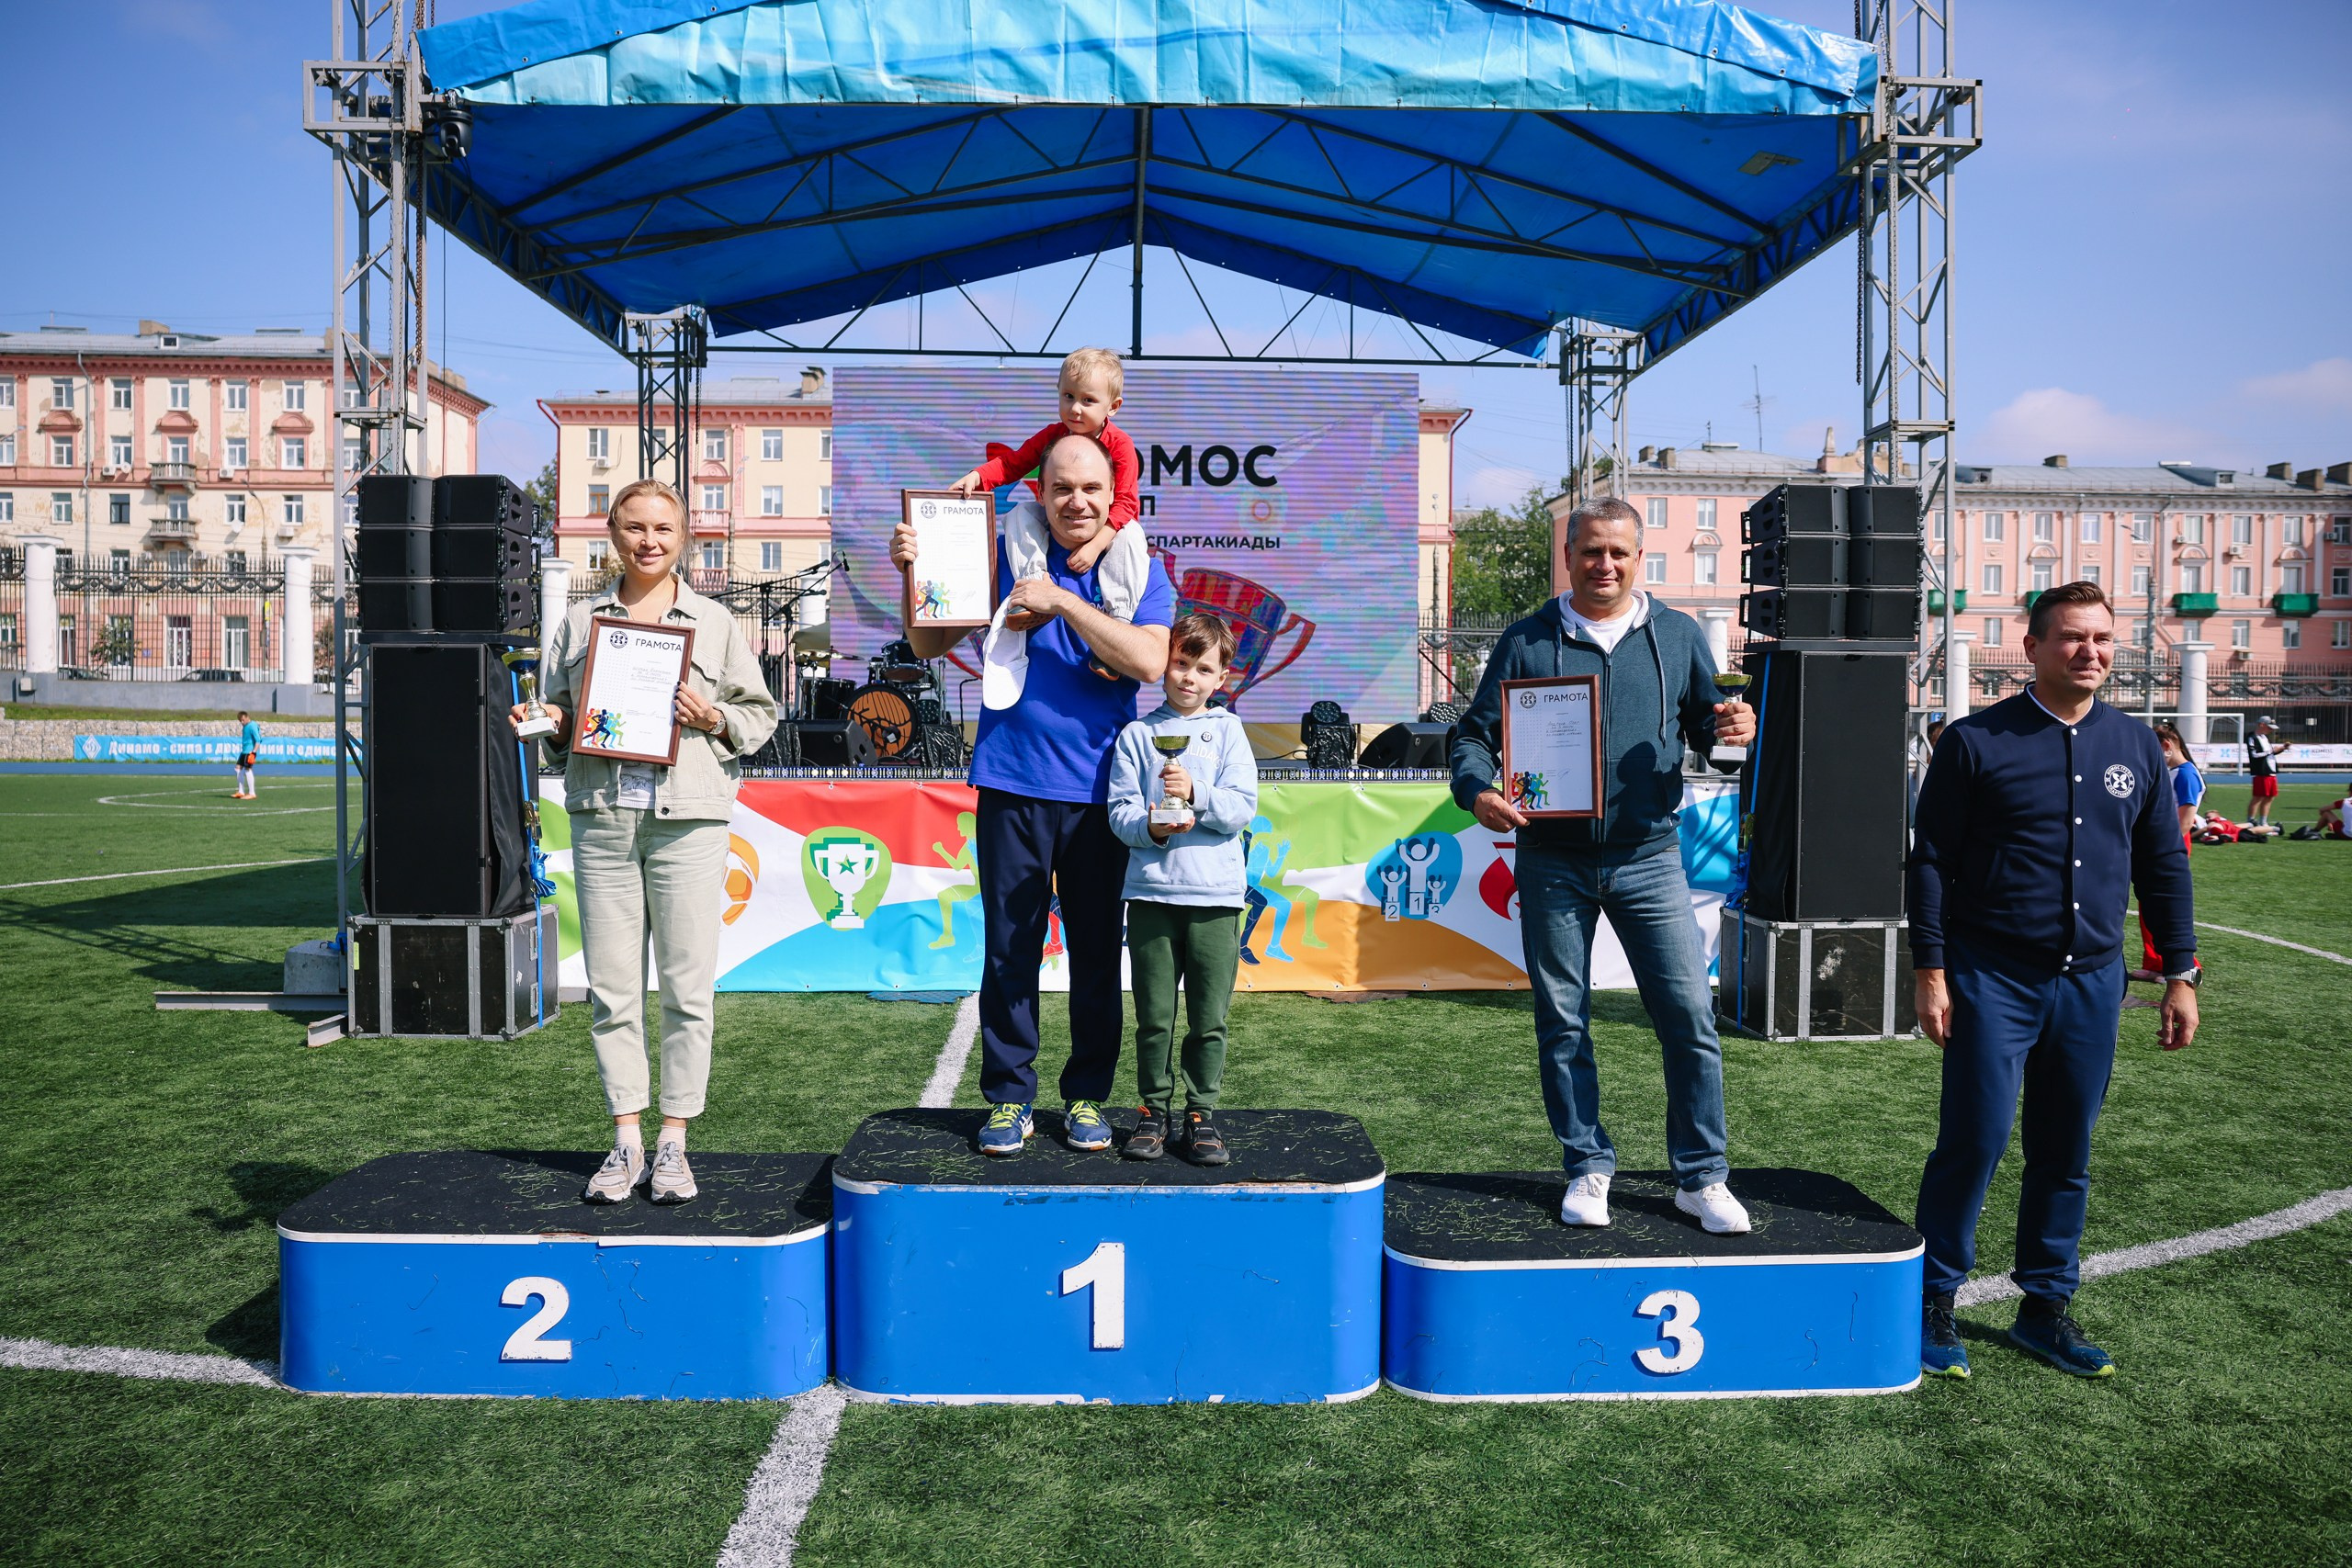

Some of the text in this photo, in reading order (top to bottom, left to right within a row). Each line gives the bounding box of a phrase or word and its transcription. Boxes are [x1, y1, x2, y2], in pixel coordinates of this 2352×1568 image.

[1135, 445, 1278, 487] МОС
[944, 506, 984, 515] ГРАМОТА
[1146, 536, 1280, 550] СПАРТАКИАДЫ
[635, 637, 682, 652] ГРАМОТА
[1544, 693, 1589, 703] ГРАМОТА
[108, 740, 160, 755] Динамо
[170, 742, 202, 754] сила
[205, 742, 212, 754] в
[215, 742, 283, 756] двинии
[287, 744, 295, 756] и
[1414, 897, 1420, 910] 1
[1387, 904, 1397, 919] 2
[1062, 1242, 1125, 1348] 1
[501, 1276, 572, 1360] 2
[1636, 1290, 1704, 1373] 3
